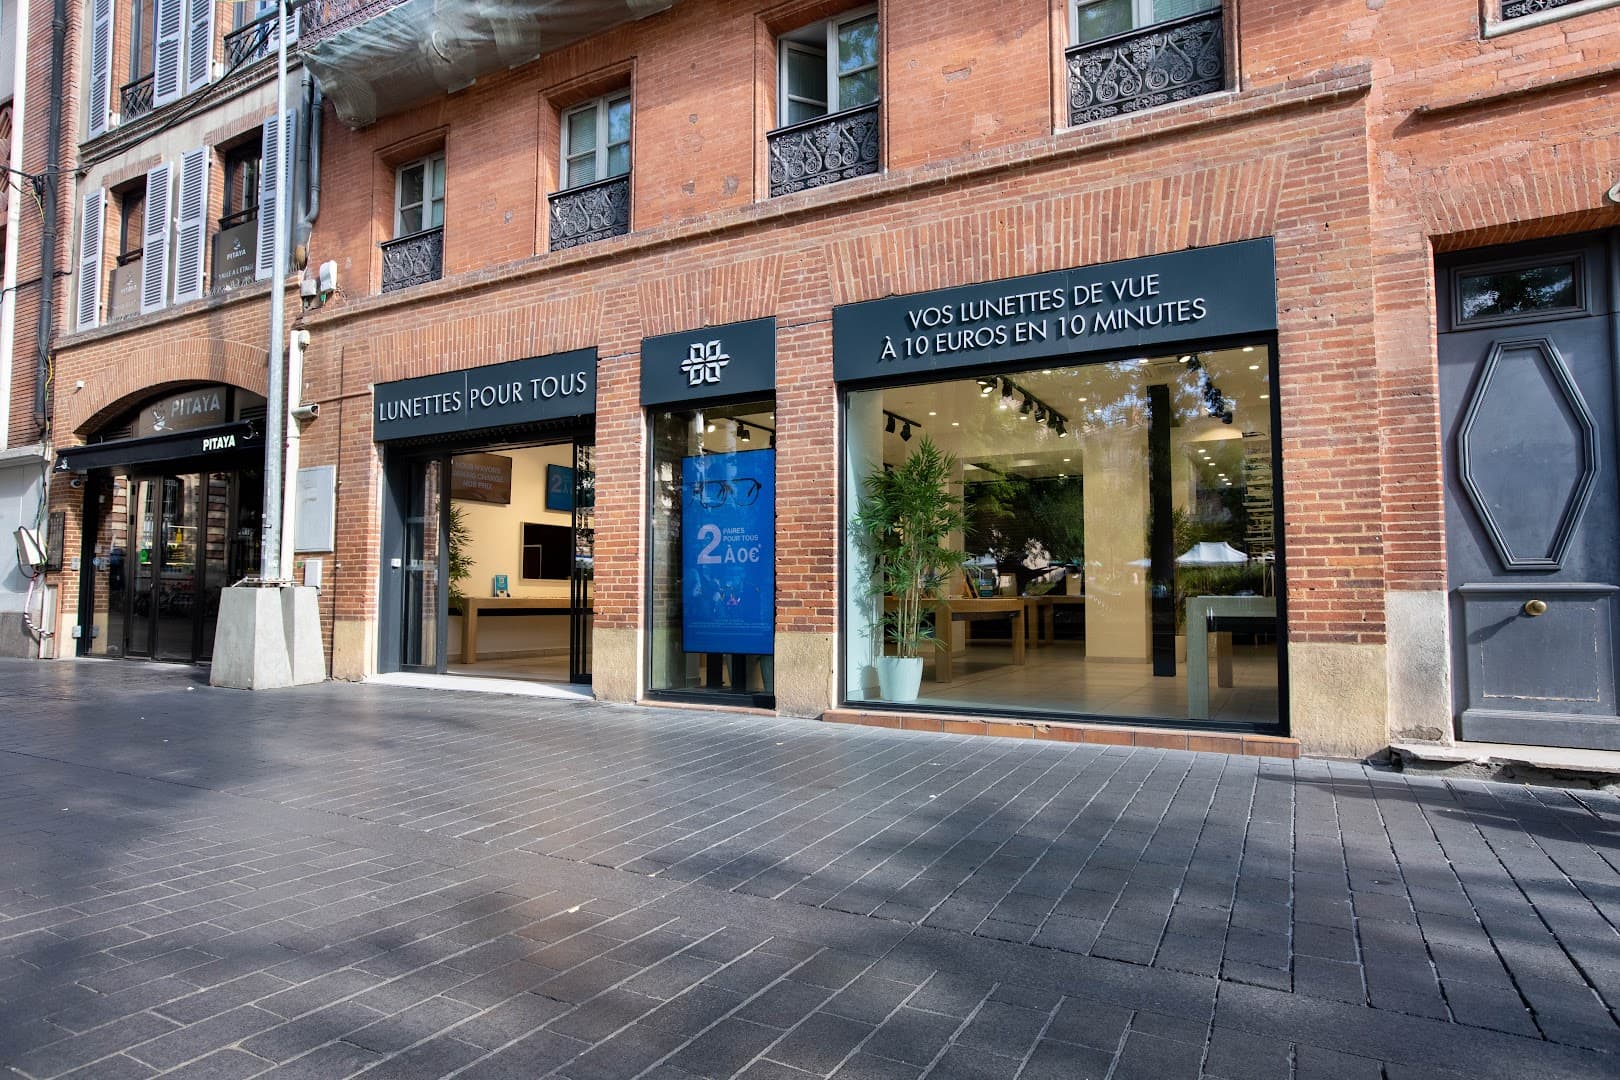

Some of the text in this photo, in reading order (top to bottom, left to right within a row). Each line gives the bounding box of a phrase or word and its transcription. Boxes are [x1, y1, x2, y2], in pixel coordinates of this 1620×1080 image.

[226, 248, 247, 261] PITAYA
[909, 273, 1160, 329] VOS LUNETTES DE VUE
[881, 298, 1207, 360] À 10 EUROS EN 10 MINUTES
[170, 393, 221, 417] PITAYA
[379, 371, 588, 421] LUNETTES POUR TOUS
[202, 434, 236, 451] PITAYA
[697, 524, 722, 564] 2
[722, 527, 745, 535] PAIRES
